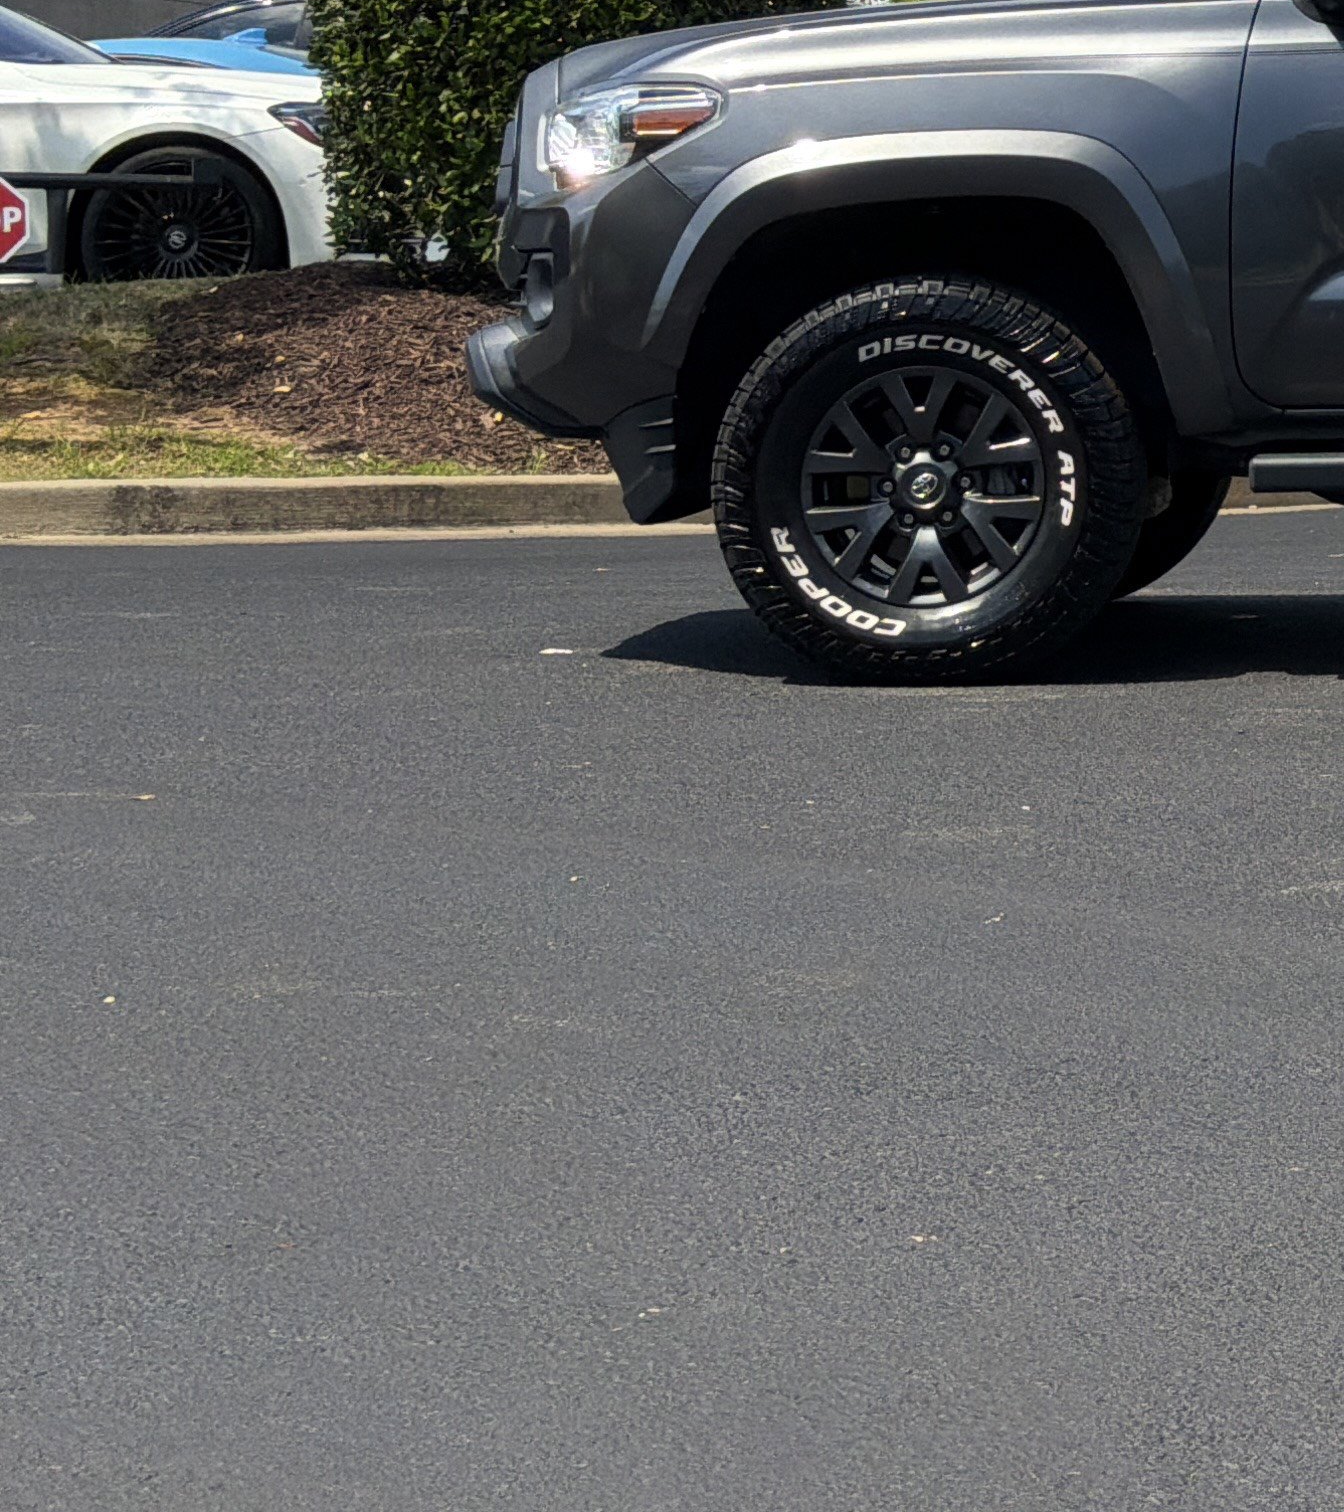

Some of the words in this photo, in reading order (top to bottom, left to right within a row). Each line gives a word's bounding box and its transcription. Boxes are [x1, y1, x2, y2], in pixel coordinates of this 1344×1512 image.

[857, 333, 1065, 434] DISCOVERER
[1056, 449, 1076, 527] ATP
[770, 526, 907, 636] COOPER
